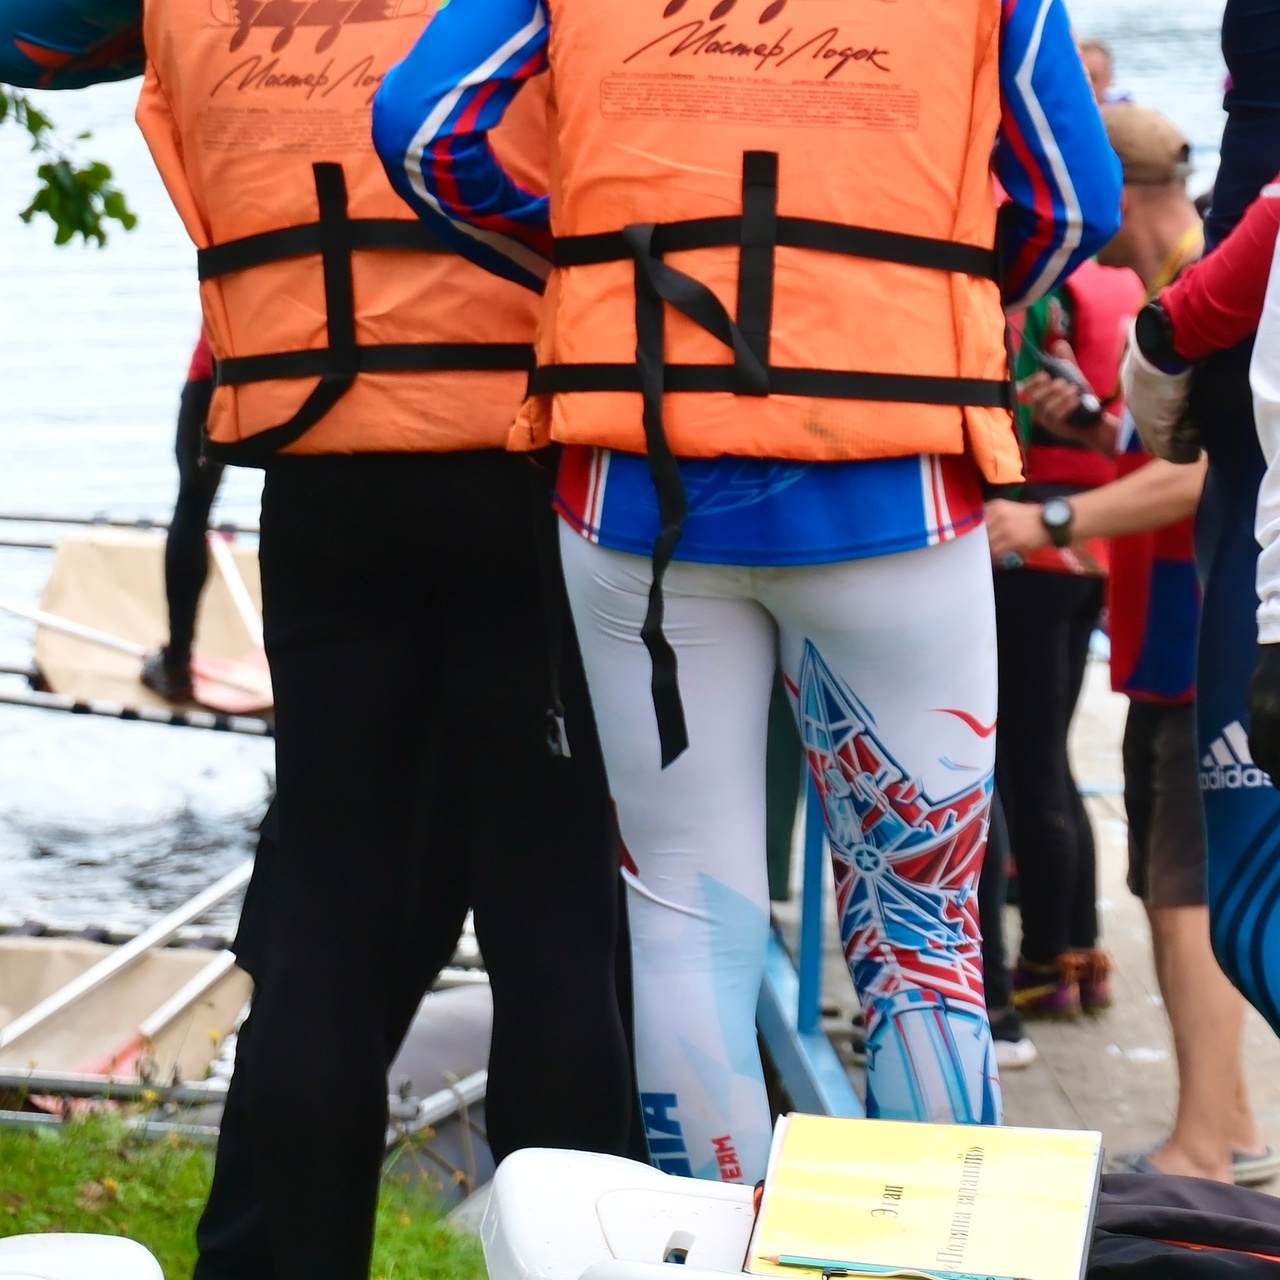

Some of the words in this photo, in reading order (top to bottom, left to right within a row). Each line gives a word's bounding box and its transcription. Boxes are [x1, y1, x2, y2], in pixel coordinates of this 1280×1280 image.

[623, 20, 792, 71] Мастер
[775, 27, 891, 80] Лодок
[210, 54, 335, 100] Мастер
[711, 1134, 744, 1185] EAM
[870, 1184, 904, 1219] Этап
